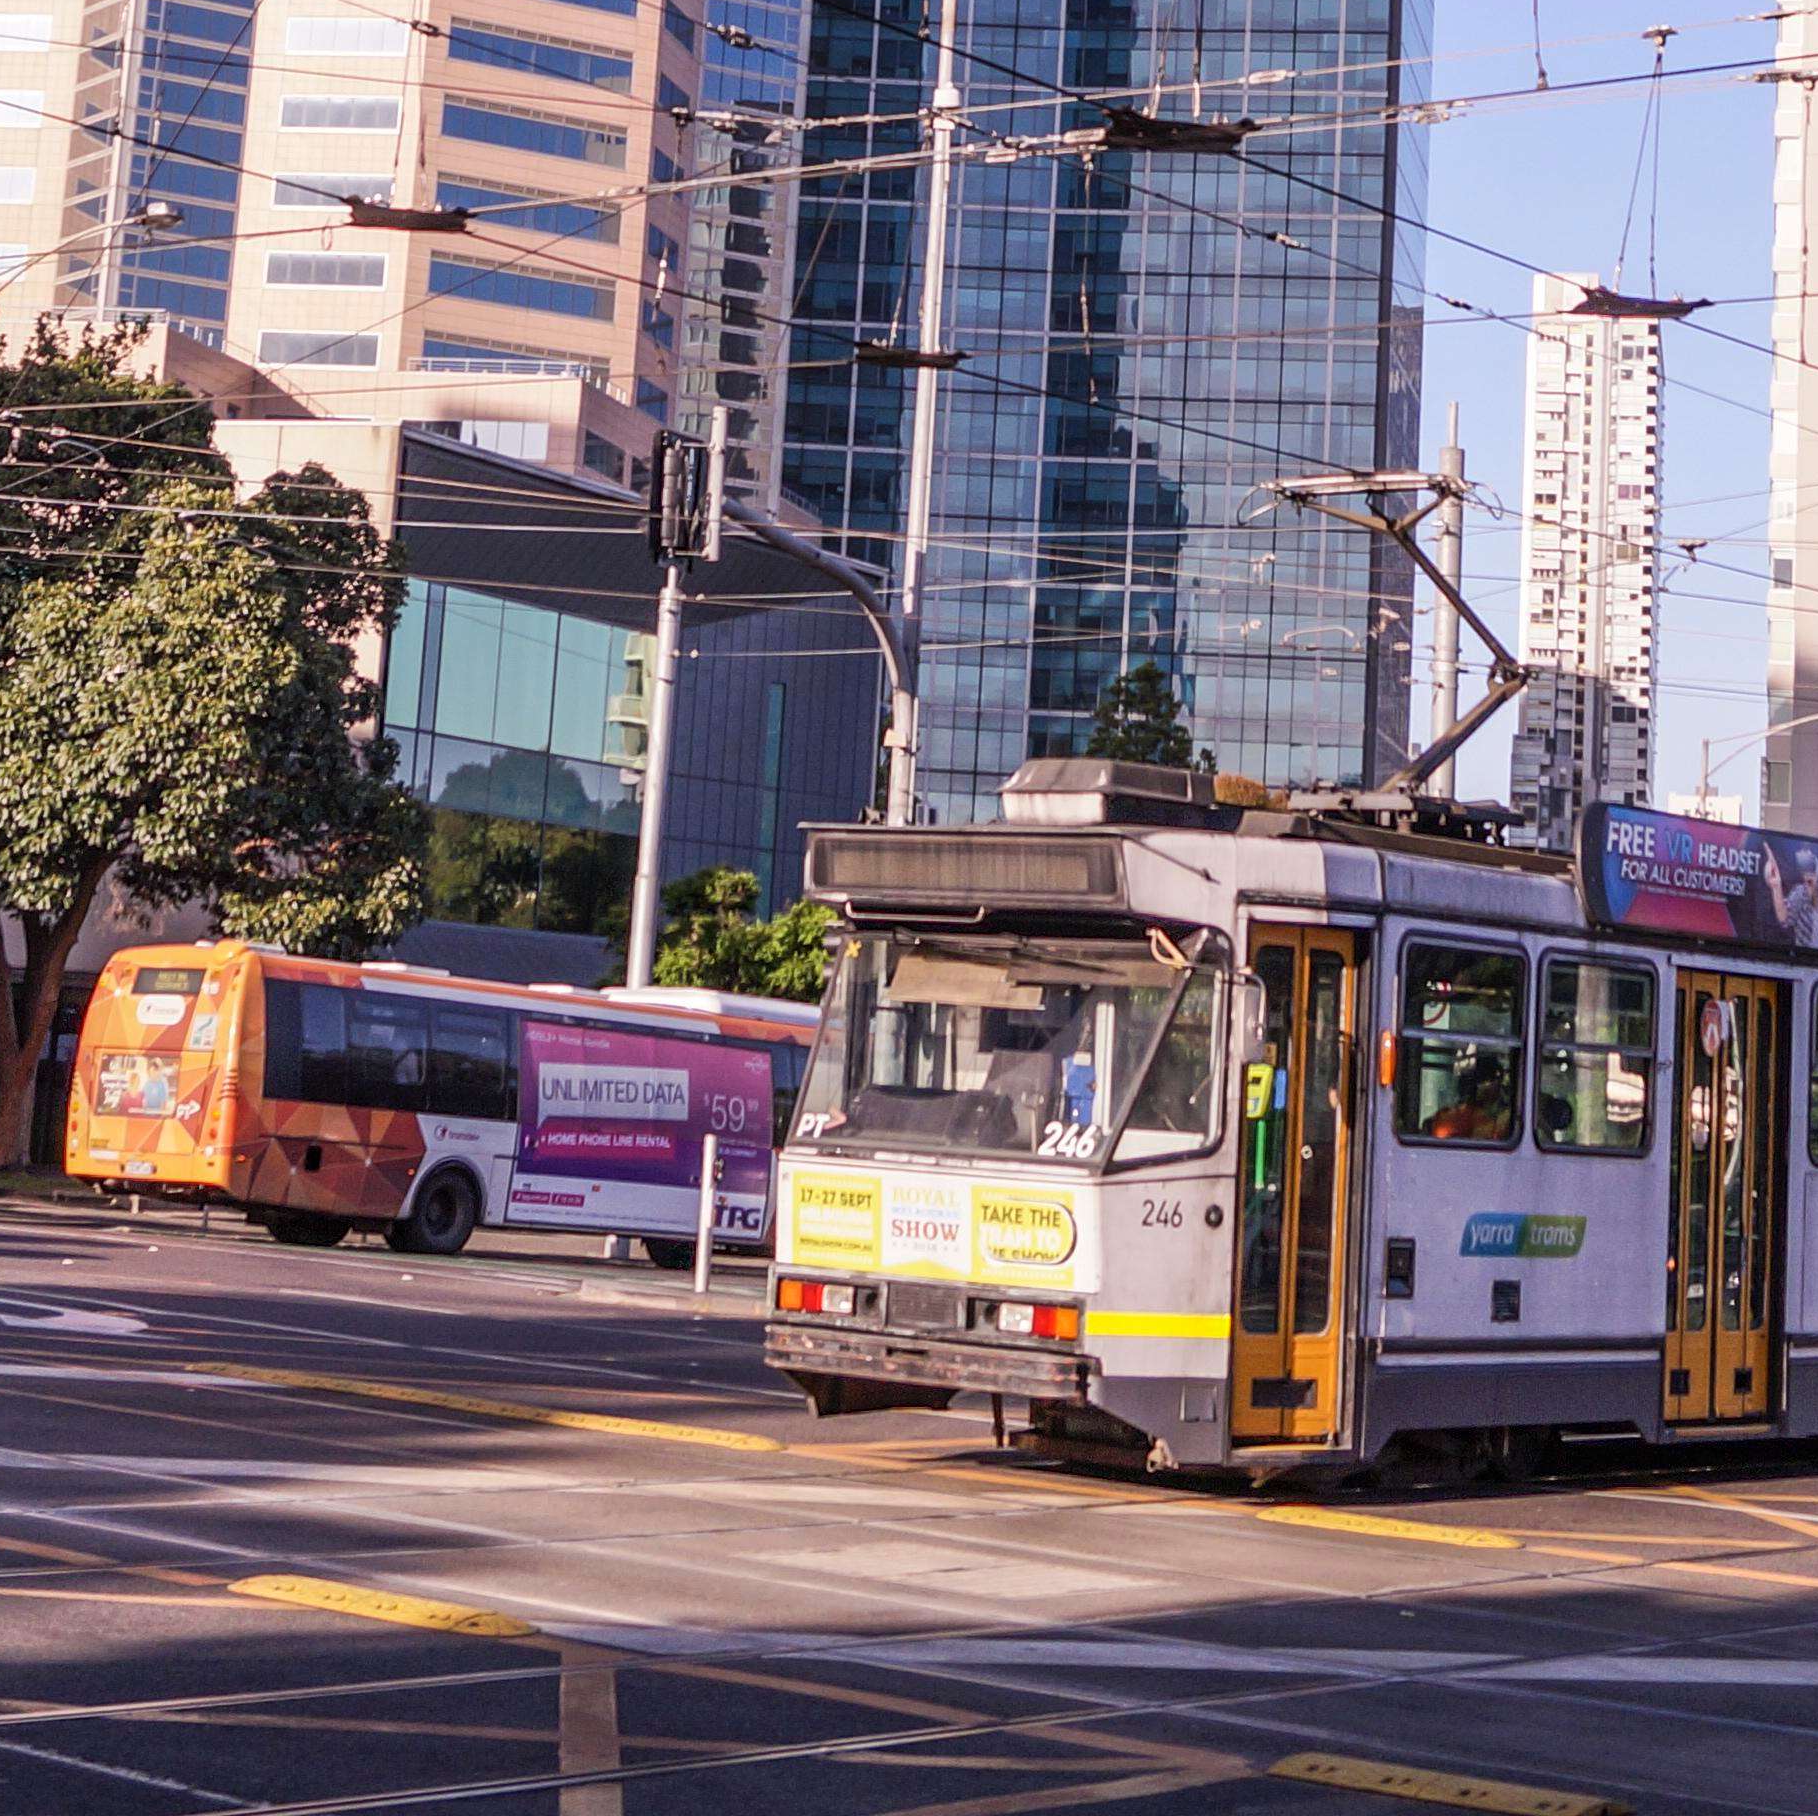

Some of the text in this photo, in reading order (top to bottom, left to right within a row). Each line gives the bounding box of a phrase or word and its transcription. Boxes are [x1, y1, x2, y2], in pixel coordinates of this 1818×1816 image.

[1606, 821, 1761, 876] FREE VR HEADSET
[1621, 858, 1649, 881] FOR
[1649, 866, 1671, 885] ALL
[1674, 869, 1747, 896] CUSTOMERS!
[542, 1077, 686, 1105] UNLIMITED DATA
[547, 1133, 577, 1146] HOME
[578, 1134, 612, 1147] PHONE
[635, 1135, 671, 1149] RENTAL
[1037, 1121, 1097, 1159] 246
[839, 1192, 872, 1209] SEPT
[892, 1187, 960, 1208] ROYAL
[713, 1204, 761, 1231] TPG
[981, 1203, 1062, 1228] TAKE THE
[1142, 1199, 1183, 1229] 246
[891, 1219, 960, 1242] SHOW
[1469, 1223, 1576, 1250] yarra trams
